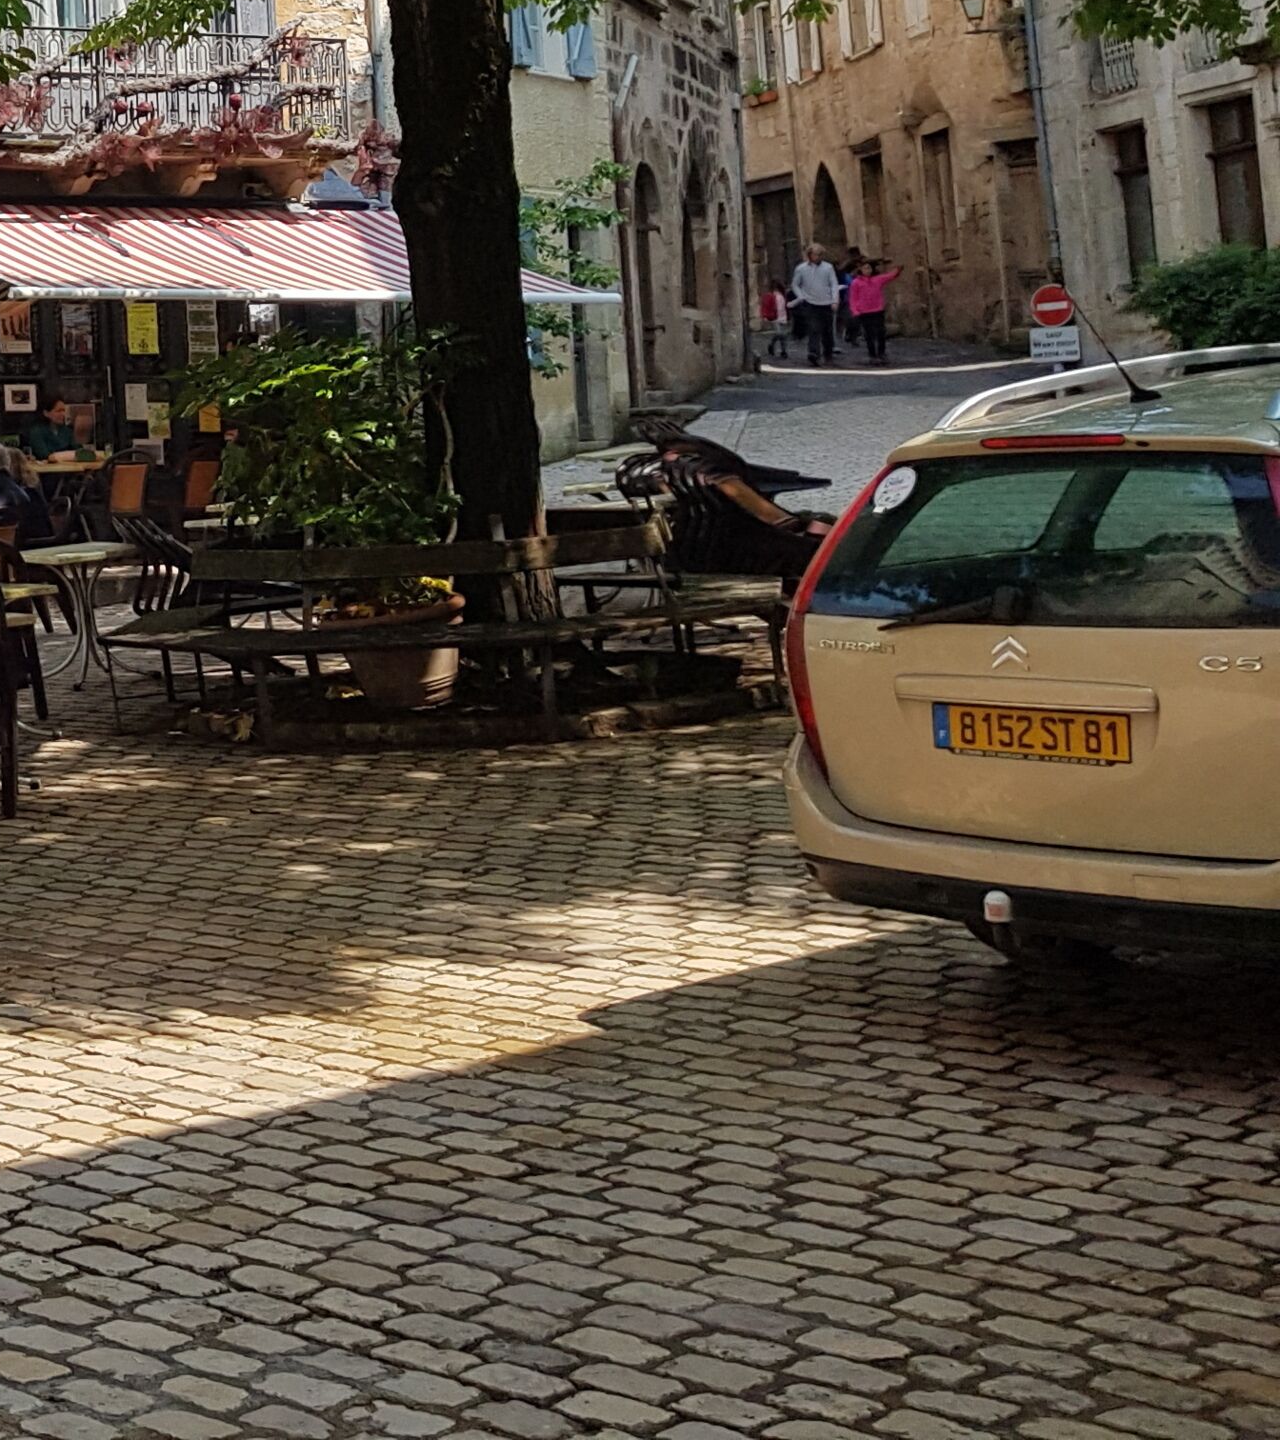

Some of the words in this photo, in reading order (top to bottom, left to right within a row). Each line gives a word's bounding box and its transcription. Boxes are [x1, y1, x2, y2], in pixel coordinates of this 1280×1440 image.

[960, 712, 1035, 749] 8152
[1040, 716, 1076, 752] ST
[1084, 720, 1119, 755] 81
